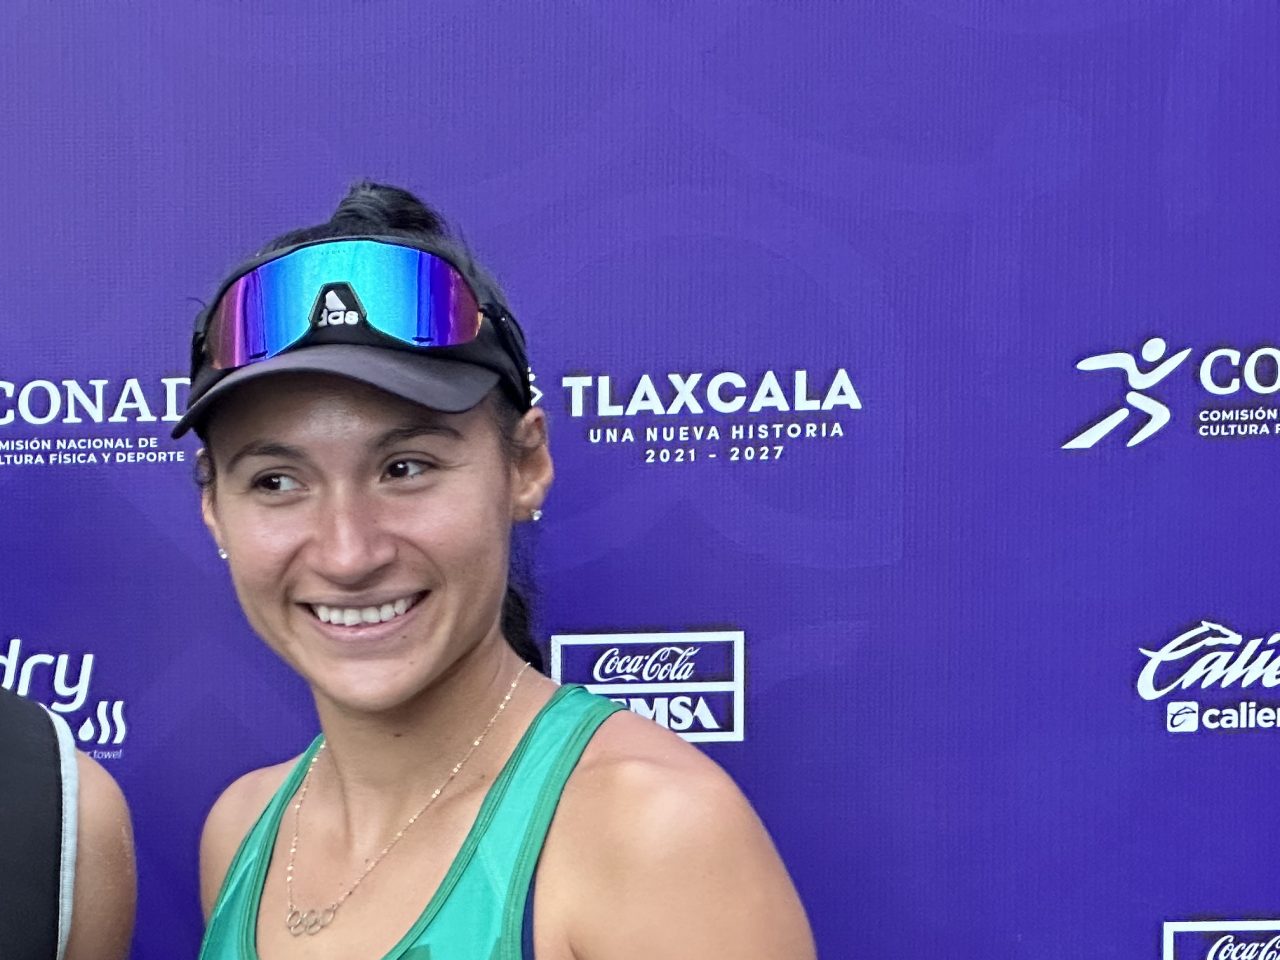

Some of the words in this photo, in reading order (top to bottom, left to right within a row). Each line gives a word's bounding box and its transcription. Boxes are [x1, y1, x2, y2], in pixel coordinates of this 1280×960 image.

[563, 368, 863, 417] TLAXCALA
[1199, 406, 1278, 421] COMISIÓN
[590, 428, 634, 443] UNA
[646, 426, 720, 442] NUEVA
[731, 423, 844, 440] HISTORIA
[1199, 423, 1270, 436] CULTURA
[56, 437, 133, 450] NACIONAL
[138, 437, 158, 448] DE
[48, 451, 98, 465] FÍSICA
[101, 453, 111, 464] Y
[115, 452, 185, 463] DEPORTE
[645, 448, 696, 463] 2021
[730, 446, 784, 461] 2027
[592, 646, 701, 682] Coca-Cola
